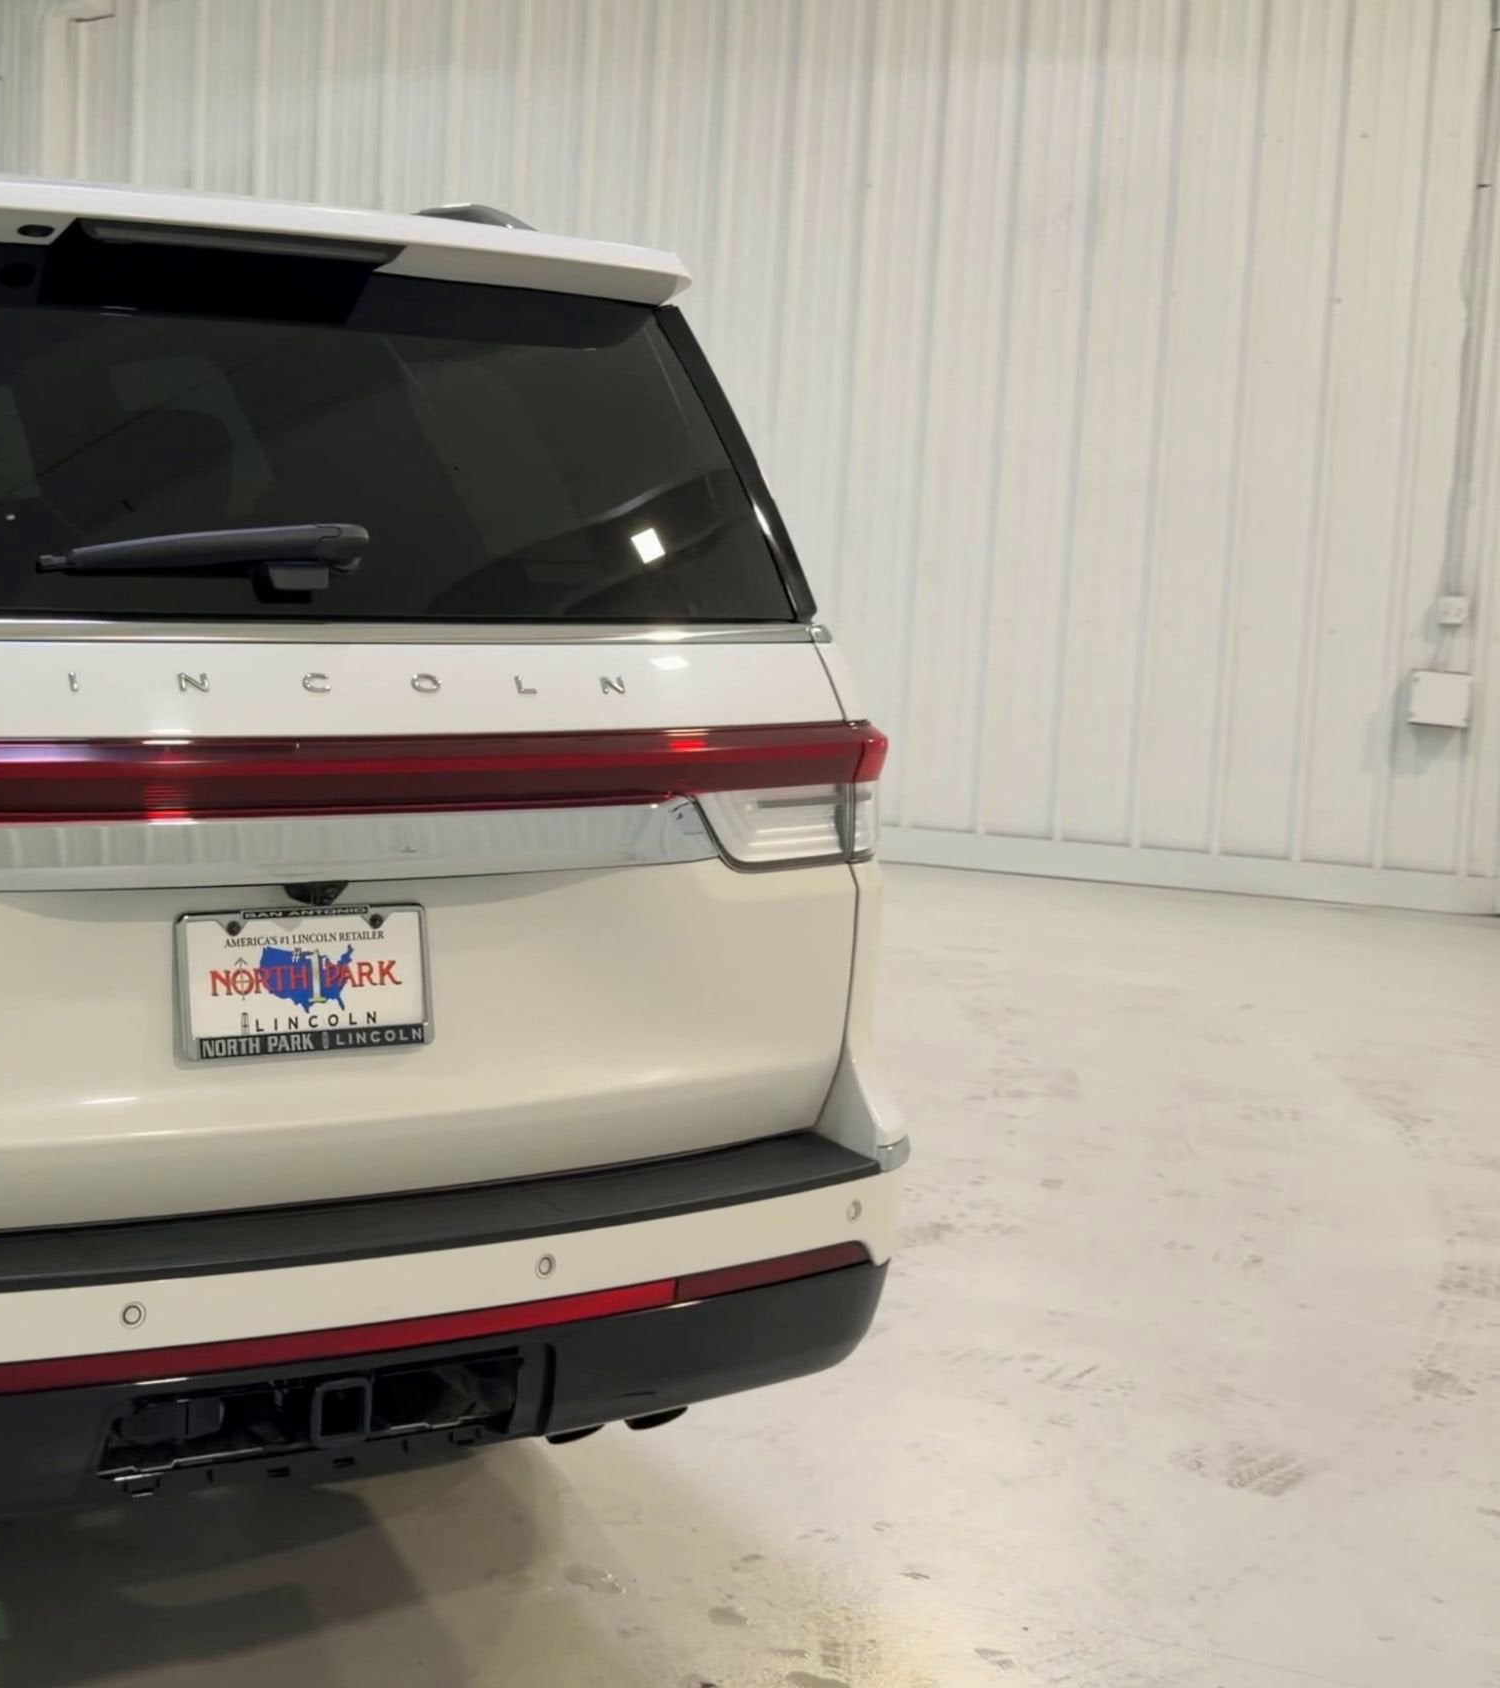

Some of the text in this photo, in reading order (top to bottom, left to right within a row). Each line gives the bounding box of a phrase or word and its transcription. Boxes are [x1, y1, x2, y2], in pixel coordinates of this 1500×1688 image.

[288, 906, 367, 917] ANTONIO
[225, 930, 384, 949] AMERICA'S #1 LINCOLN RETAILER
[210, 960, 403, 996] NORTH PARK
[255, 1011, 378, 1032] LINCOLN
[202, 1028, 422, 1058] NORTH PARK LINCOLN
